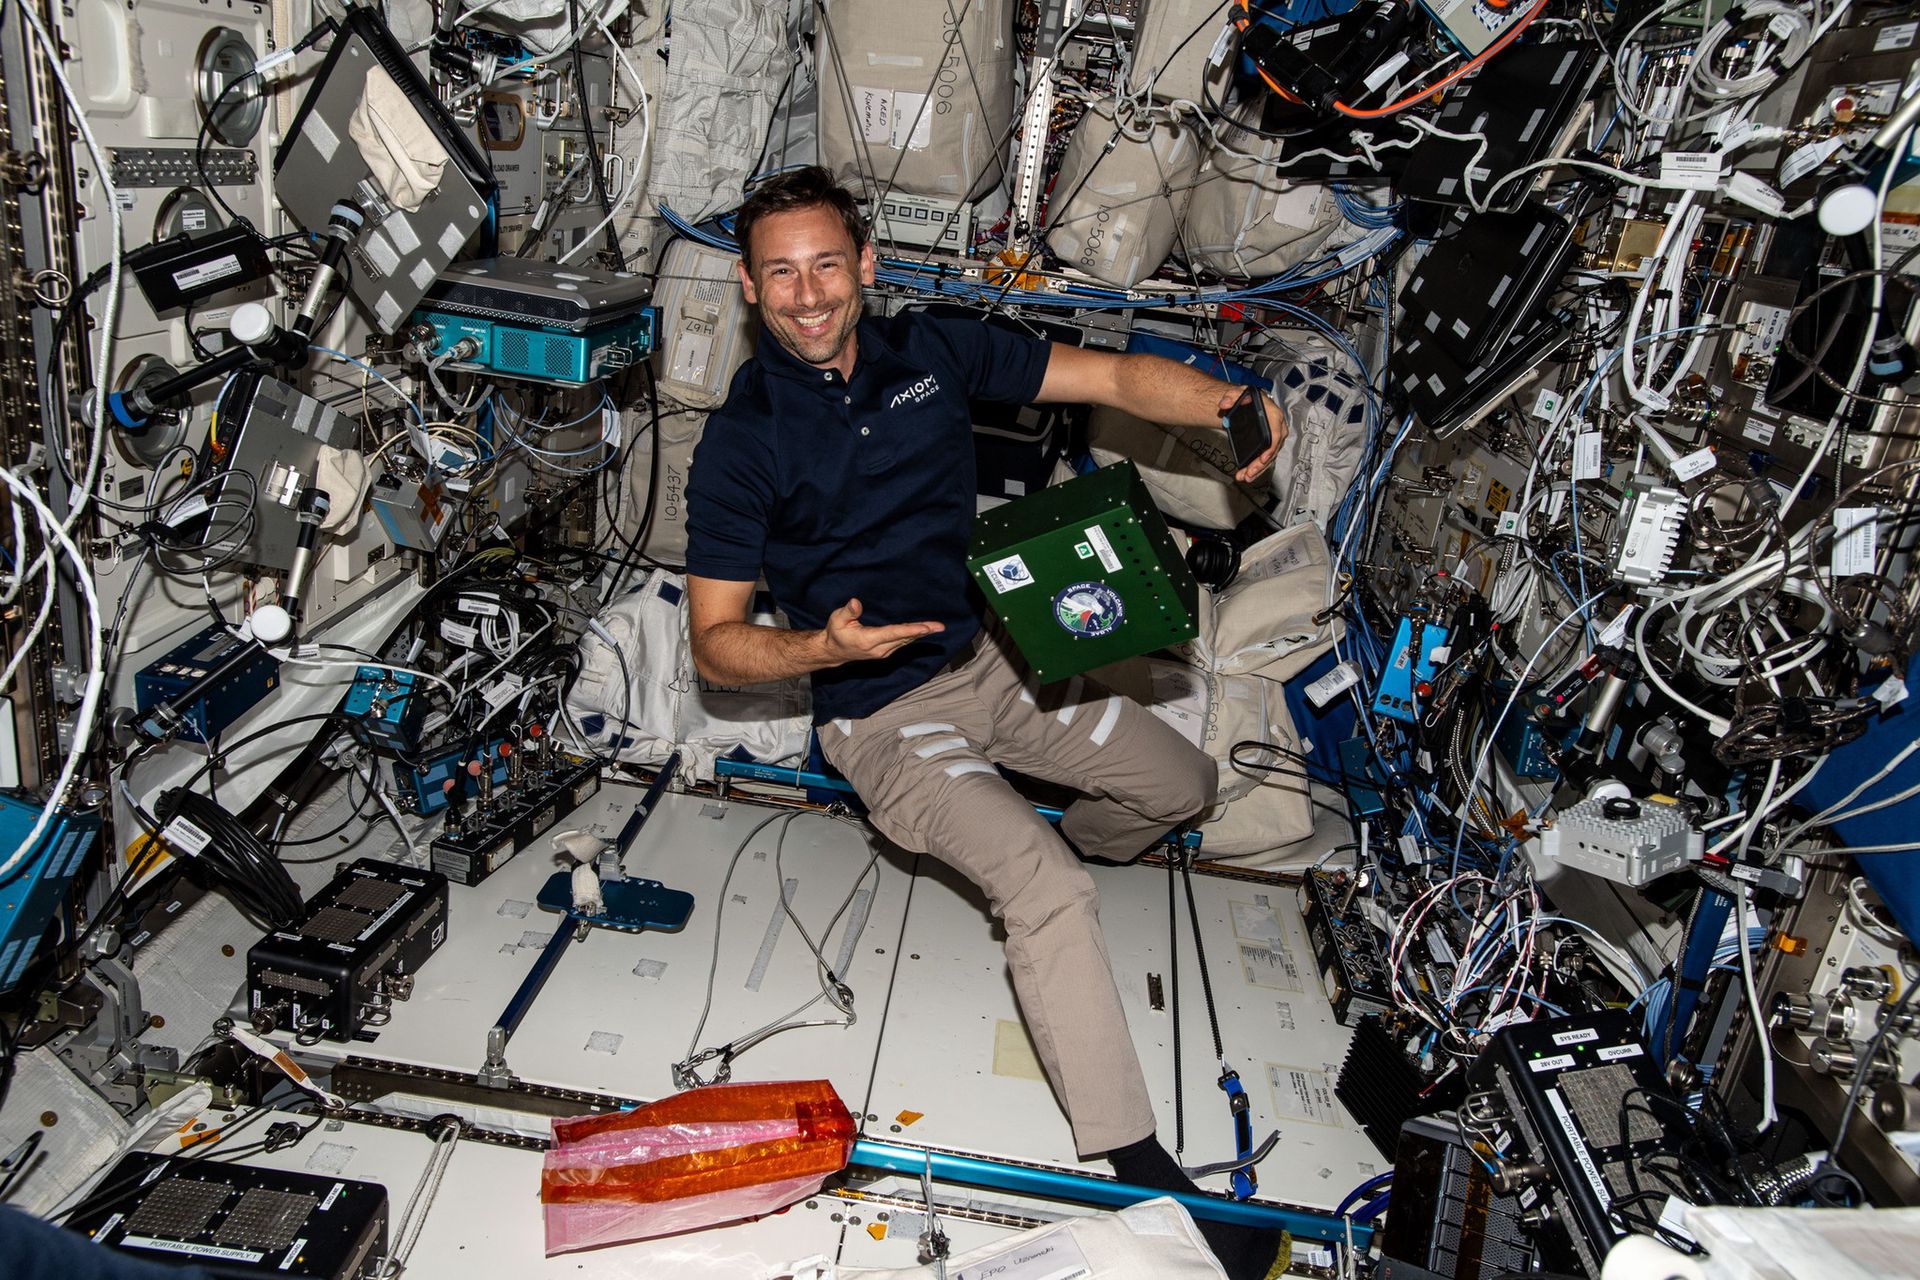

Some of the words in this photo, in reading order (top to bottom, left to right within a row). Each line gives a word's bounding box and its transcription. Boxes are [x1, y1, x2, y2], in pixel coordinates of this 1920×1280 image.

[890, 374, 937, 409] AXIOM
[914, 384, 940, 403] SPACE
[1067, 583, 1091, 593] SPACE
[1107, 589, 1123, 617] VOLCANIC
[1090, 626, 1113, 637] ALGAE
[1572, 1032, 1592, 1041] READY
[1608, 1047, 1633, 1057] OVCURR
[1551, 1058, 1564, 1067] OUT
[1562, 1115, 1585, 1158] PORTABLE
[1583, 1158, 1602, 1188] POWER
[150, 1240, 195, 1253] PORTABLE
[196, 1246, 221, 1257] POWER
[221, 1250, 252, 1261] SUPPLY
